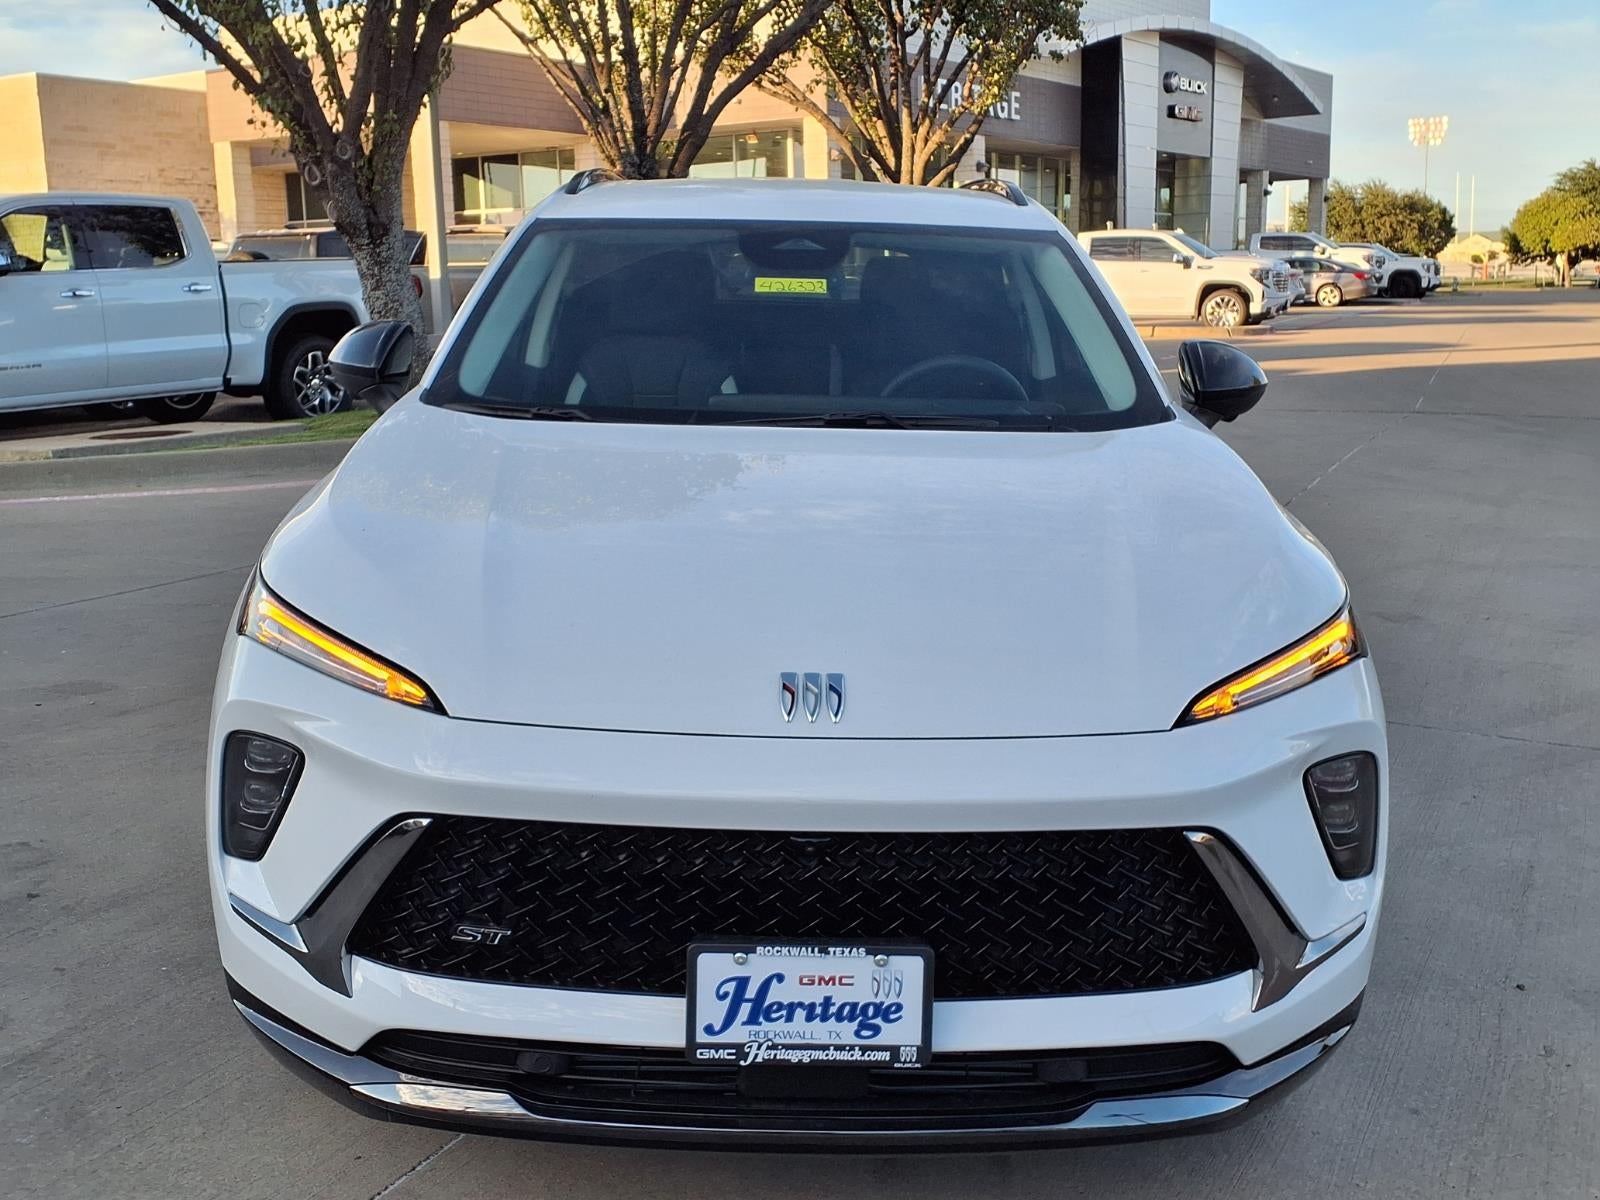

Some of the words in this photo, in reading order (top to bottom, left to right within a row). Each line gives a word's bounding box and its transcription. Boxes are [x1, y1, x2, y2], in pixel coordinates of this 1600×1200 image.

[1179, 76, 1208, 95] BUICK
[451, 926, 512, 945] ST
[756, 946, 825, 958] ROCKWALL,
[828, 947, 866, 957] TEXAS
[799, 975, 855, 987] GMC
[702, 972, 904, 1040] Heritage
[827, 1030, 843, 1040] TX
[696, 1048, 737, 1059] GMC
[739, 1040, 891, 1066] Heritagegmcbuick.com
